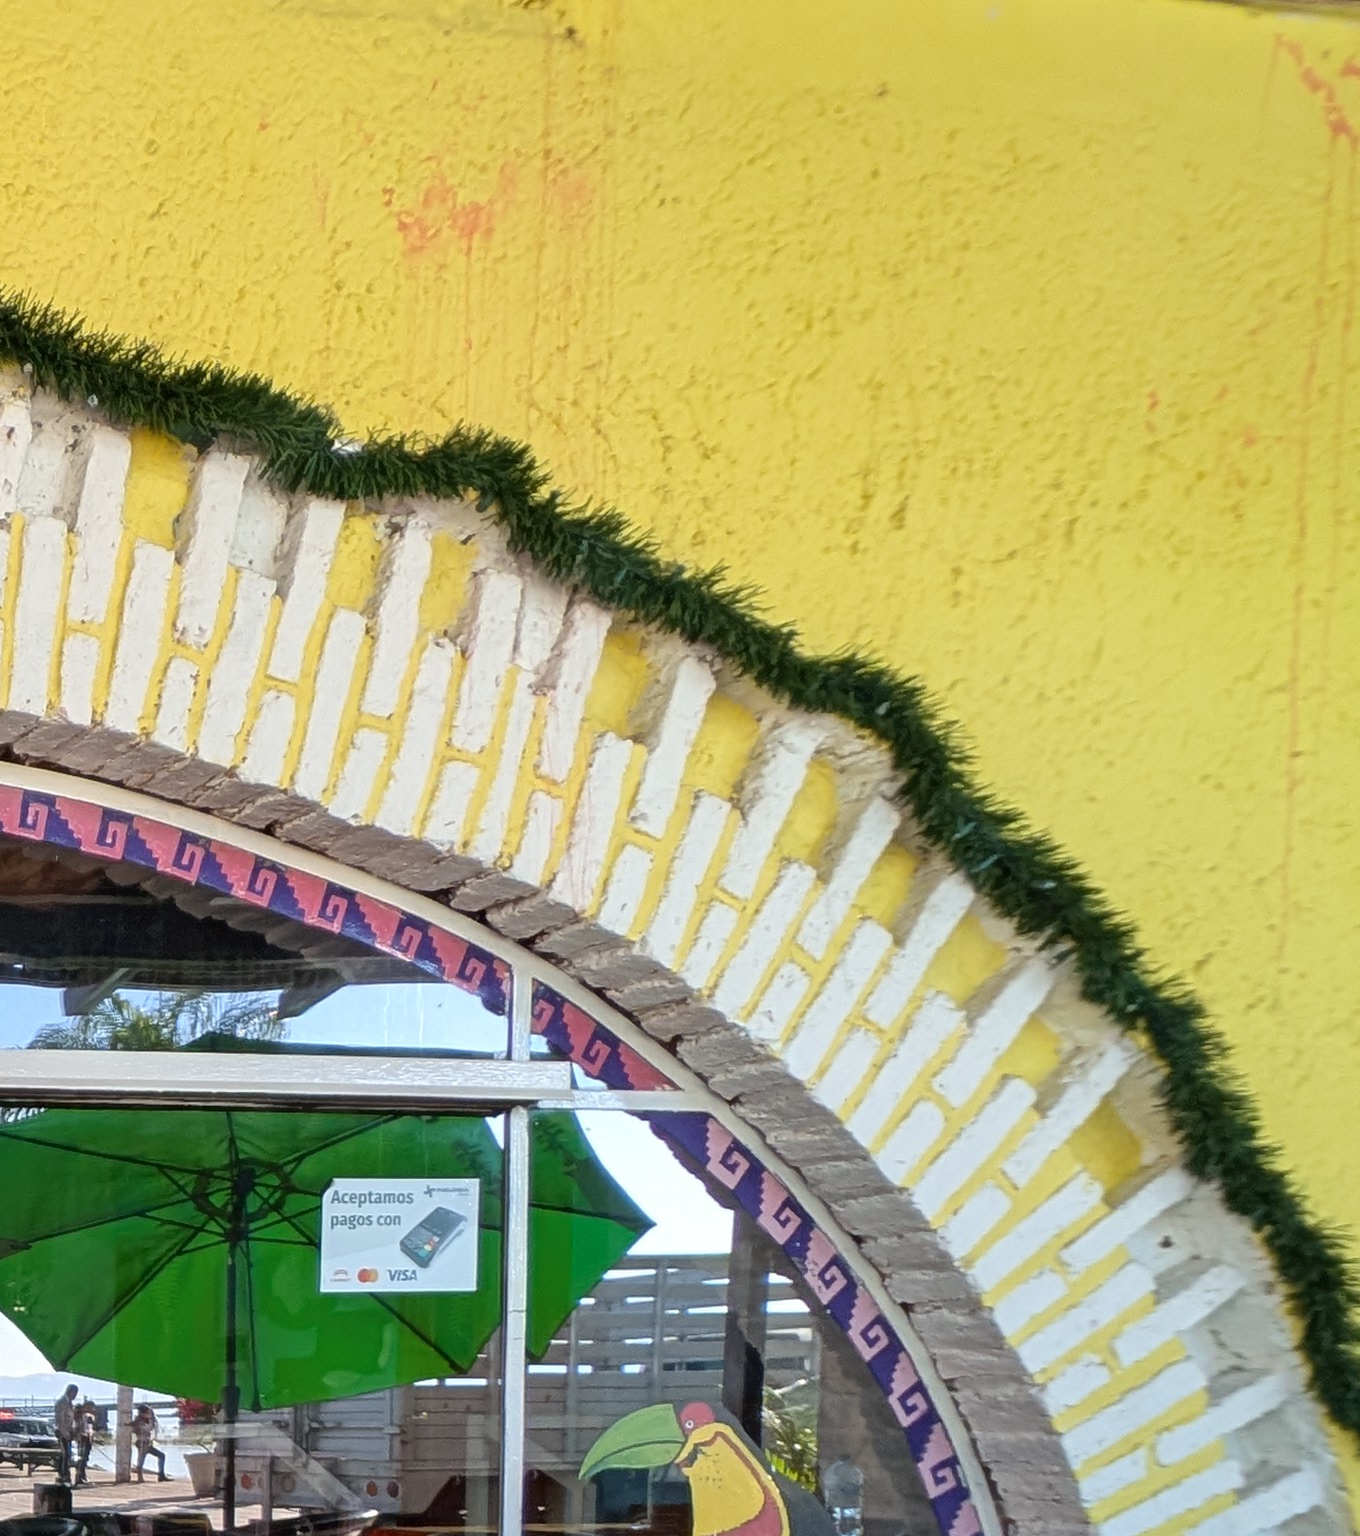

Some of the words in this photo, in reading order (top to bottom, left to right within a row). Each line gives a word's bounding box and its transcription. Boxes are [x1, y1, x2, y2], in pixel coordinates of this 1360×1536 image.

[330, 1189, 414, 1208] Aceptamos
[330, 1214, 373, 1230] pagos
[376, 1214, 402, 1227] con
[386, 1268, 418, 1282] VISA
